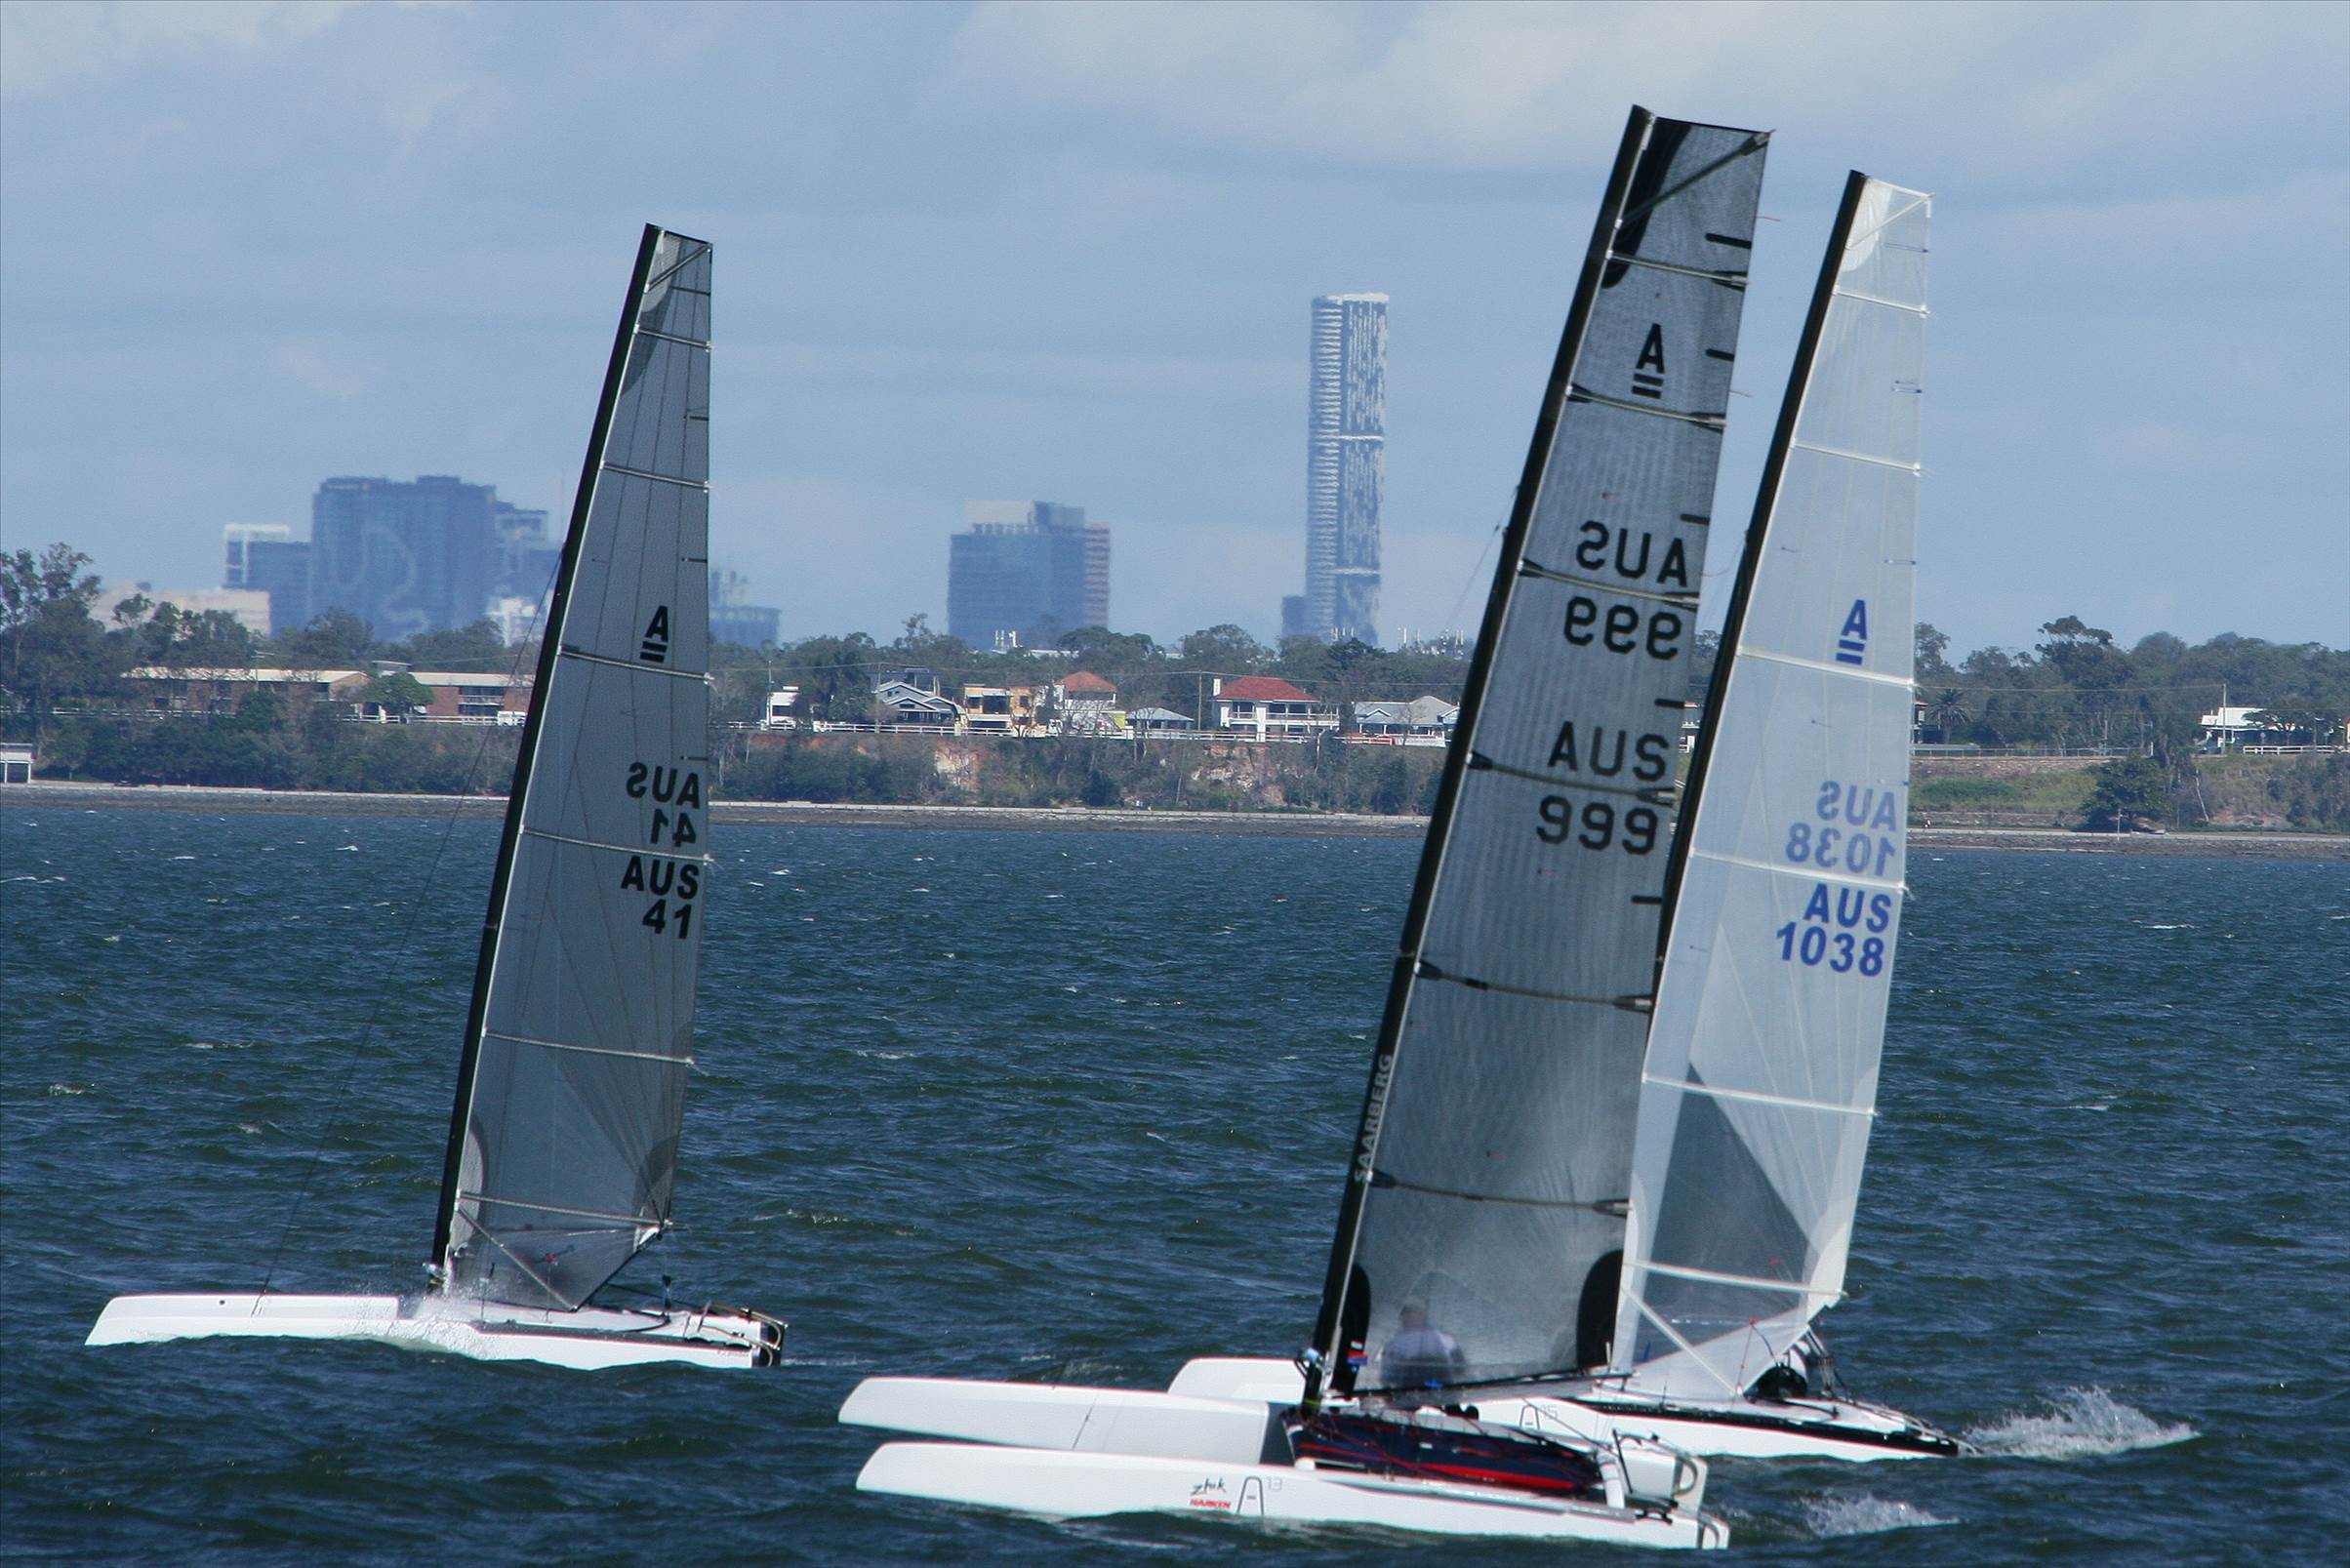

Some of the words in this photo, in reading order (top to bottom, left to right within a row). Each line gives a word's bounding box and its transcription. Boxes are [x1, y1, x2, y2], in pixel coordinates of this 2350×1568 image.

[1635, 323, 1666, 374] A
[644, 605, 669, 643] A
[1841, 599, 1868, 641] A
[1547, 721, 1669, 782] AUS
[1536, 794, 1658, 856] 999
[620, 856, 701, 900] AUS
[642, 899, 692, 940] 41
[1803, 883, 1892, 934] AUS
[1776, 921, 1885, 978] 1038
[1354, 1054, 1394, 1185] SAARBERG
